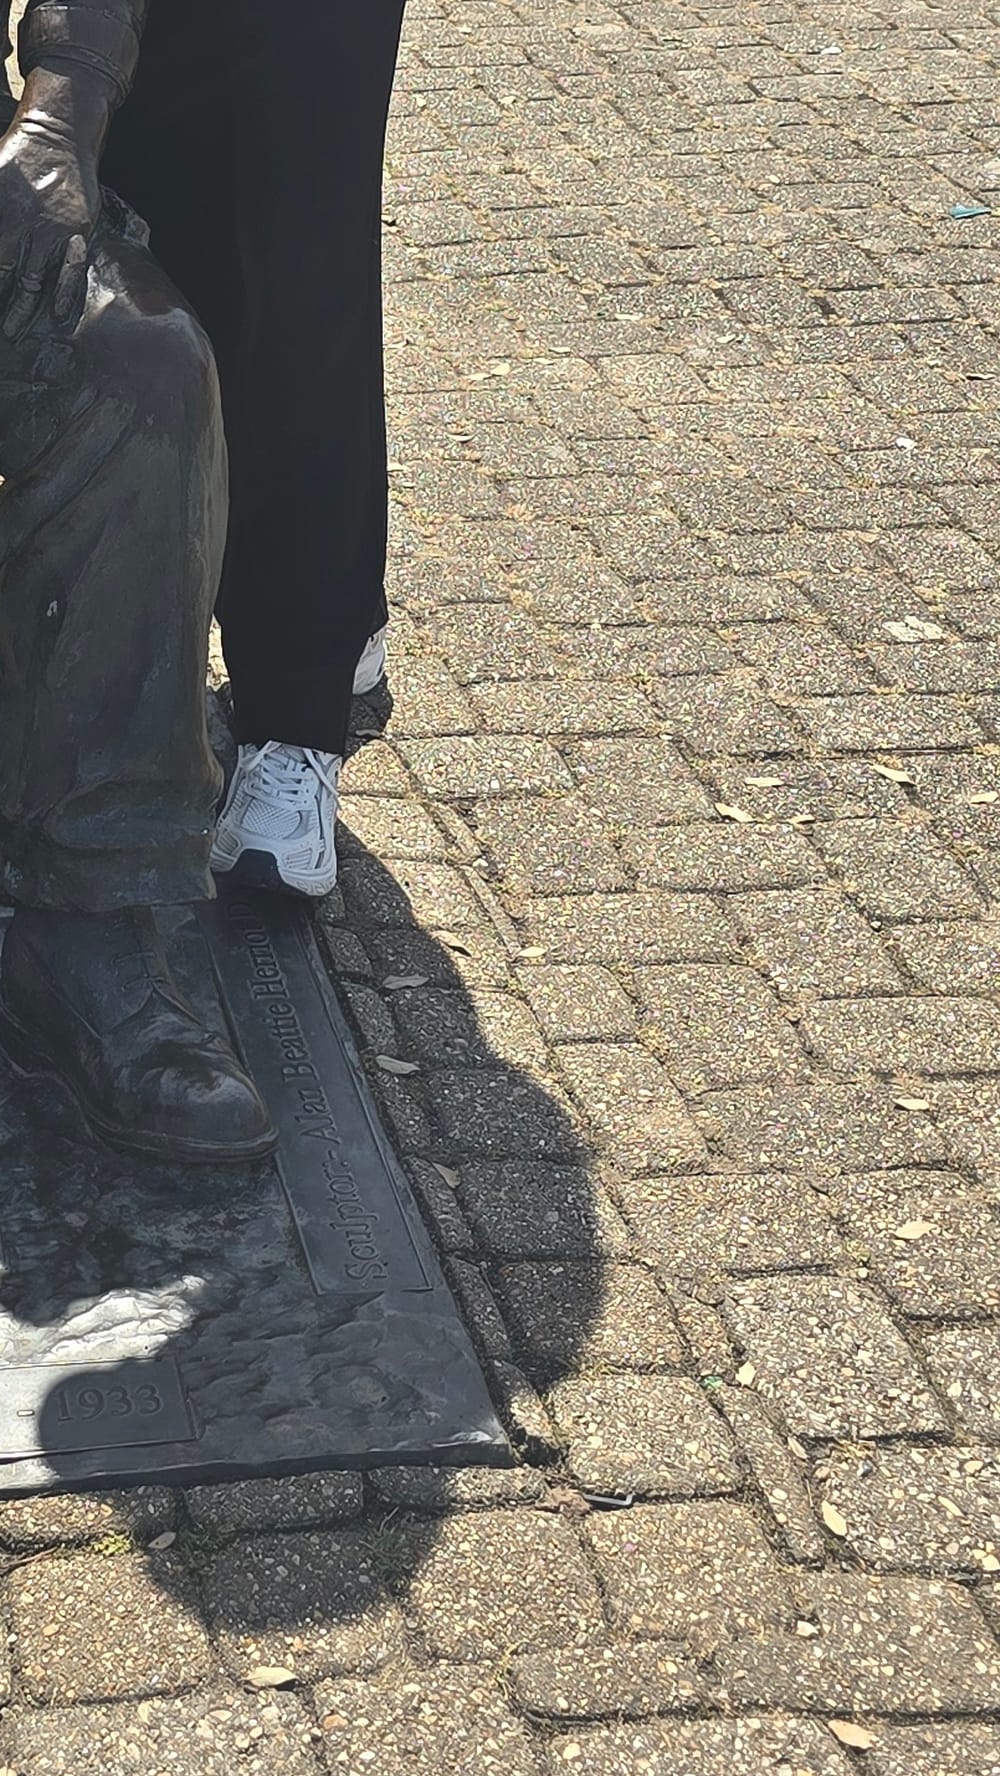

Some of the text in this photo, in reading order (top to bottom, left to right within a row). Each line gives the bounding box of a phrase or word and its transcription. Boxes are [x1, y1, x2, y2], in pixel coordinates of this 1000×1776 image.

[268, 1001, 321, 1084] Beattie
[295, 1084, 341, 1146] Alan
[55, 1383, 162, 1423] 1933
